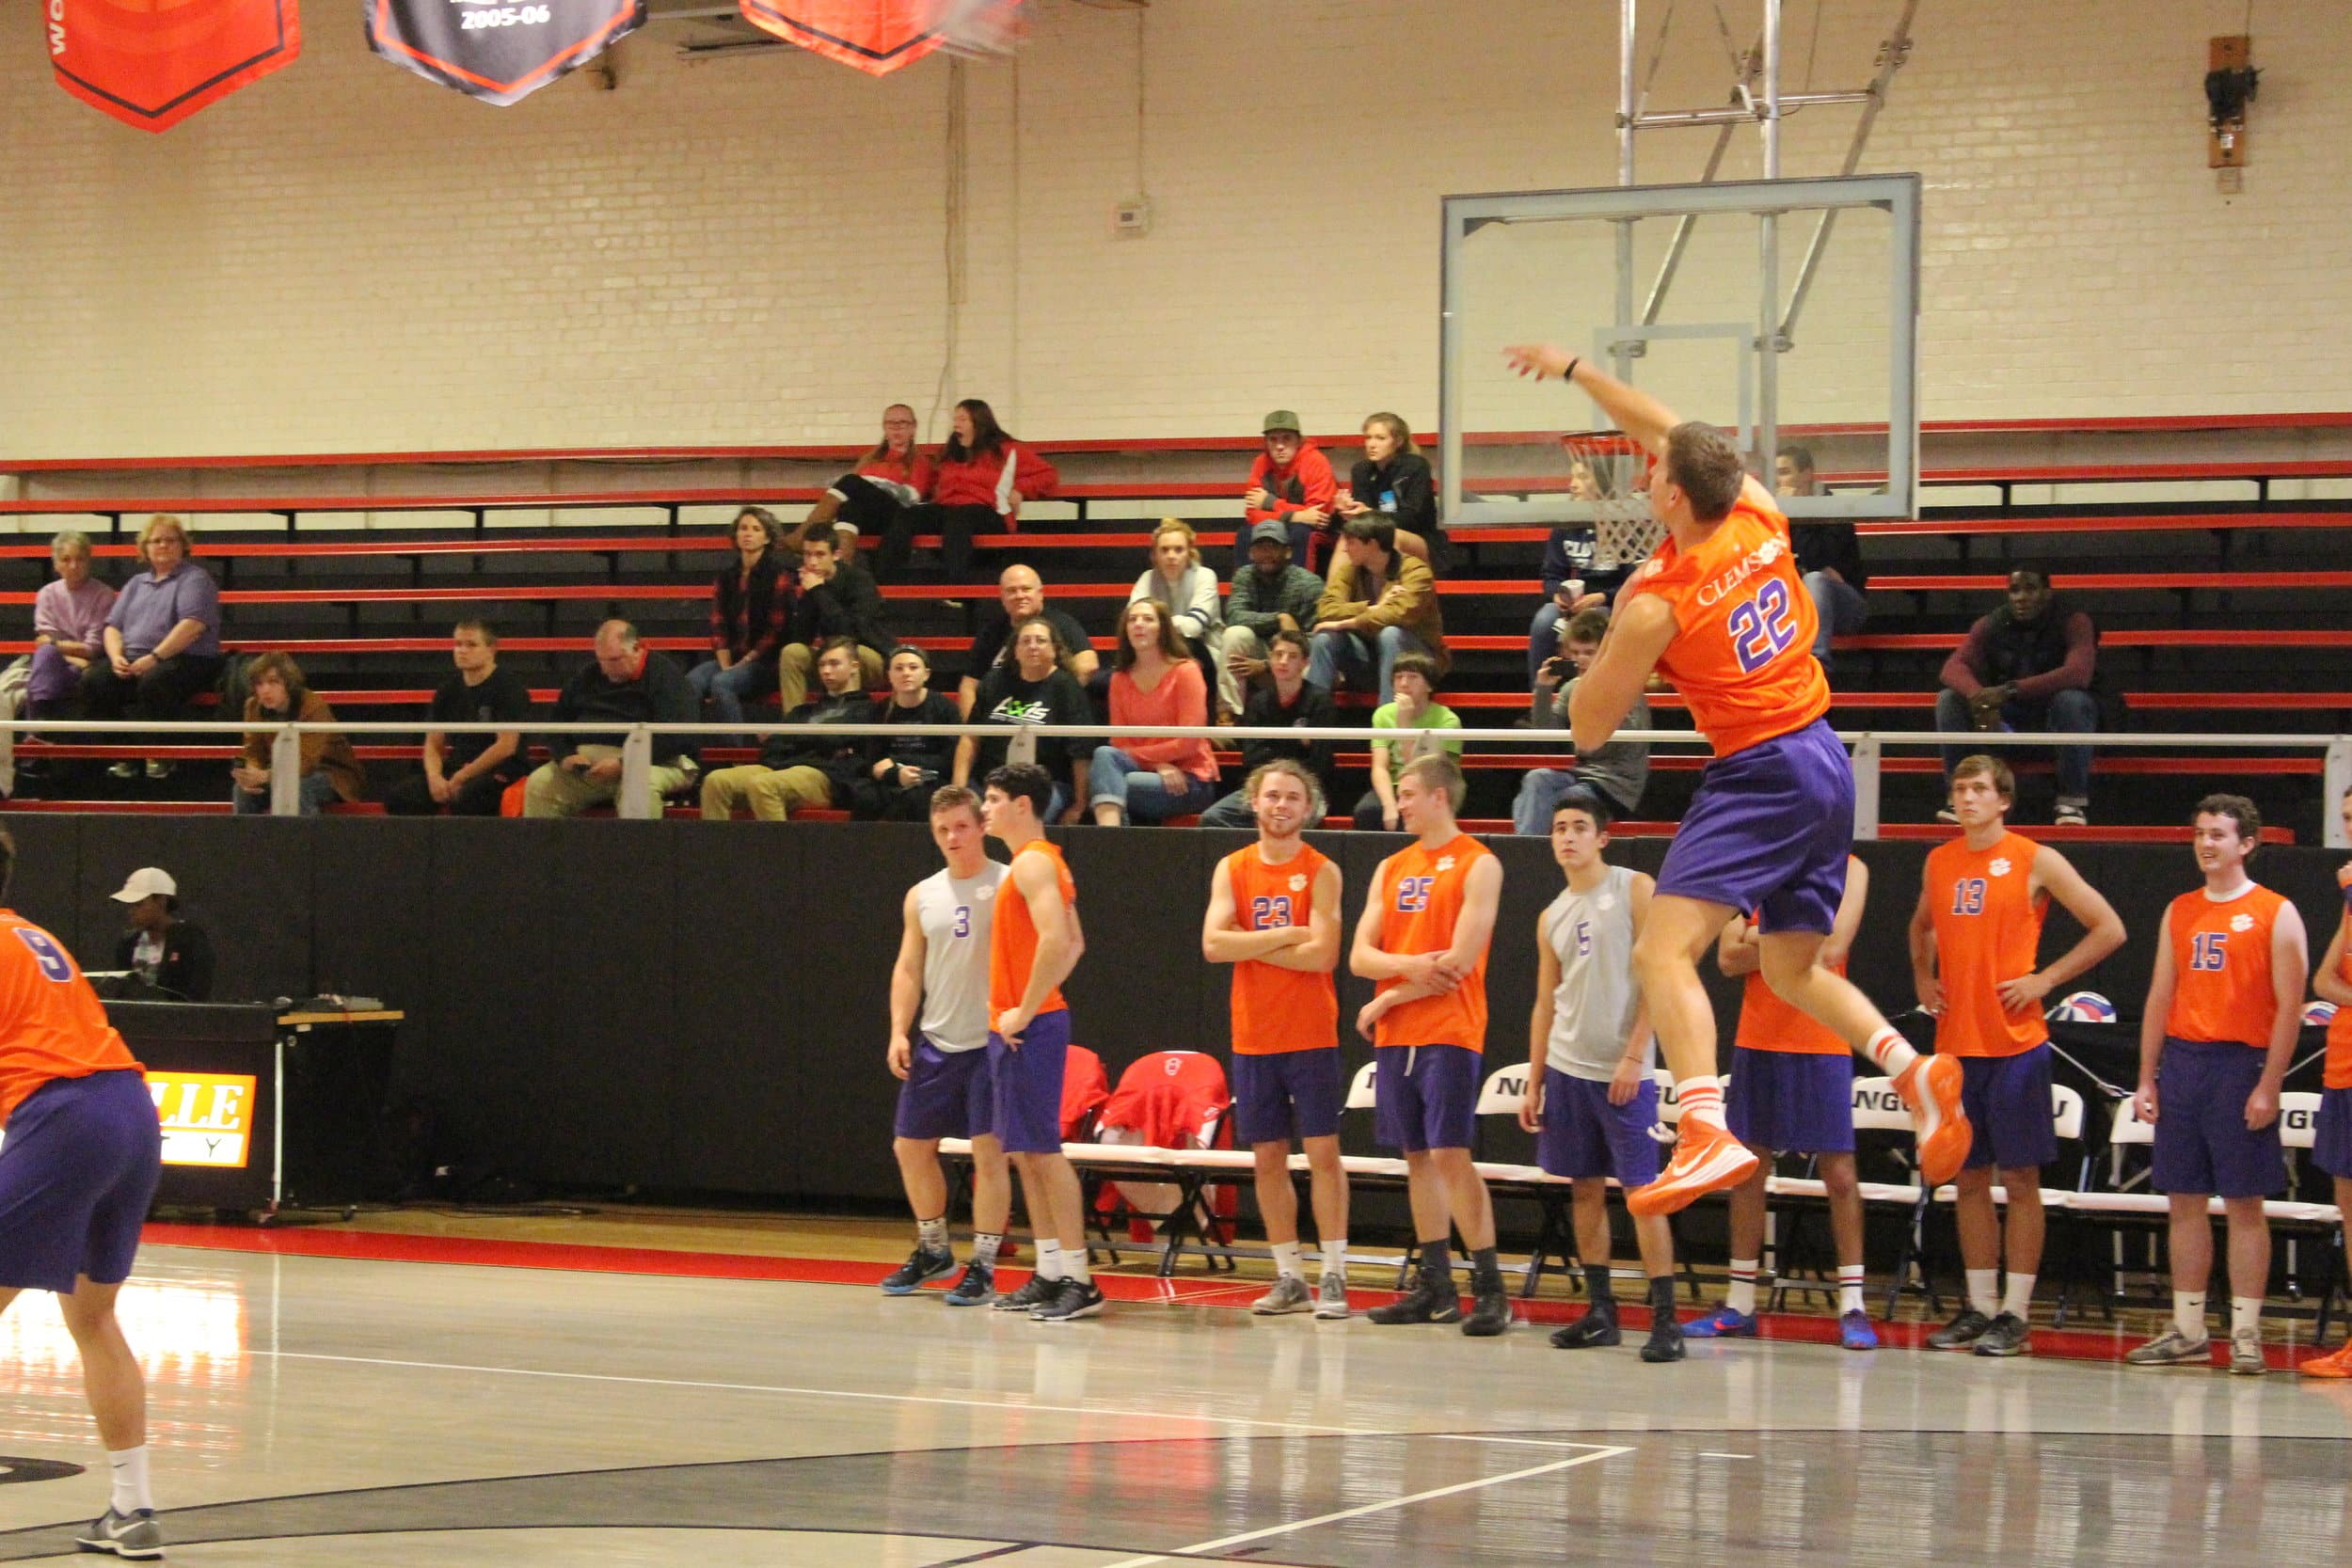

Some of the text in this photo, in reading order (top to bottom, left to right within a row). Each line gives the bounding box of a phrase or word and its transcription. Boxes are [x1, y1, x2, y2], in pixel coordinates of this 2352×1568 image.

[461, 5, 550, 29] 2005-06
[1727, 577, 1798, 673] 22
[1251, 895, 1293, 930] 23
[1396, 876, 1435, 912] 25
[1951, 878, 1987, 916] 13
[954, 905, 971, 939] 3
[1576, 919, 1592, 957] 5
[12, 927, 73, 983] 9
[2189, 931, 2228, 971] 15
